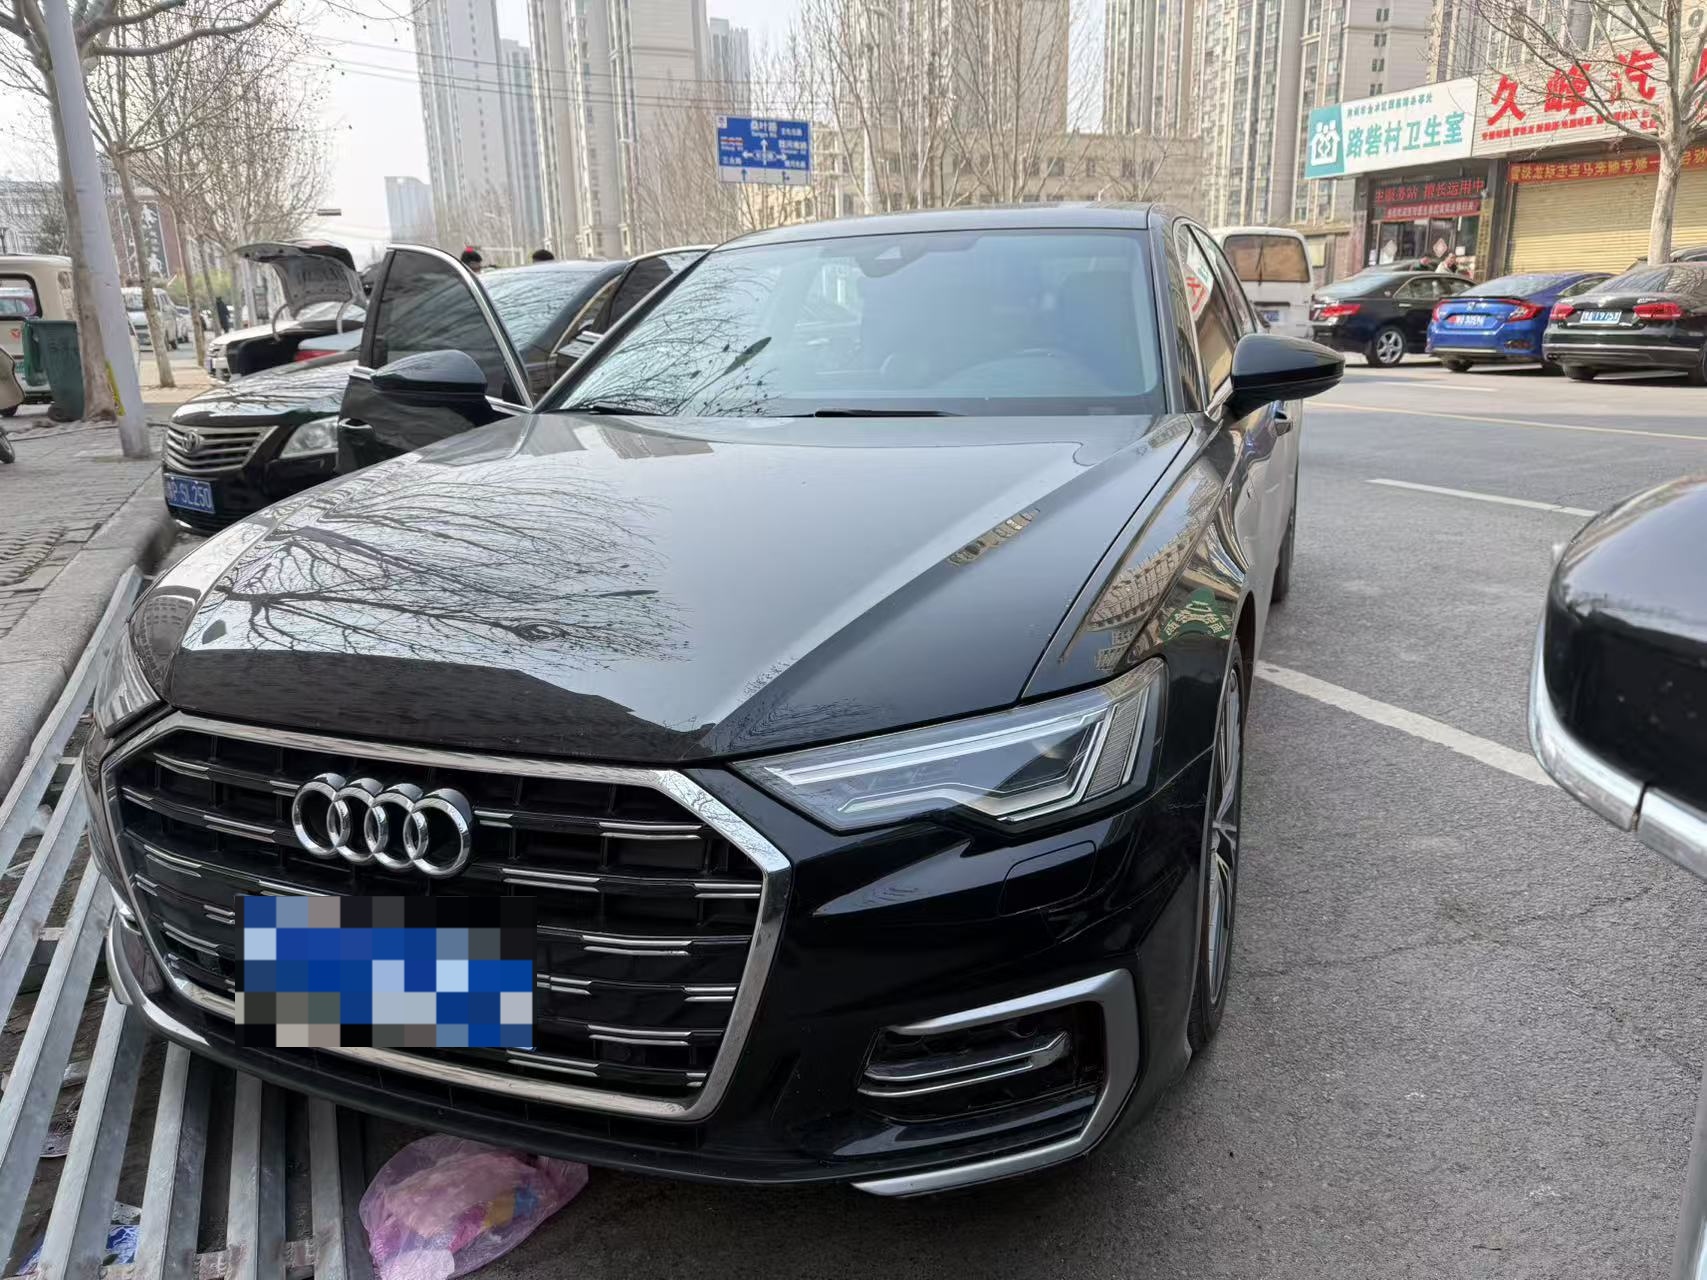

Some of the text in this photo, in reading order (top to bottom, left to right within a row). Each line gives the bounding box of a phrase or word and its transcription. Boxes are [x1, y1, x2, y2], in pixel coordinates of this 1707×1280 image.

[1345, 111, 1465, 159] 路砦村卫生室
